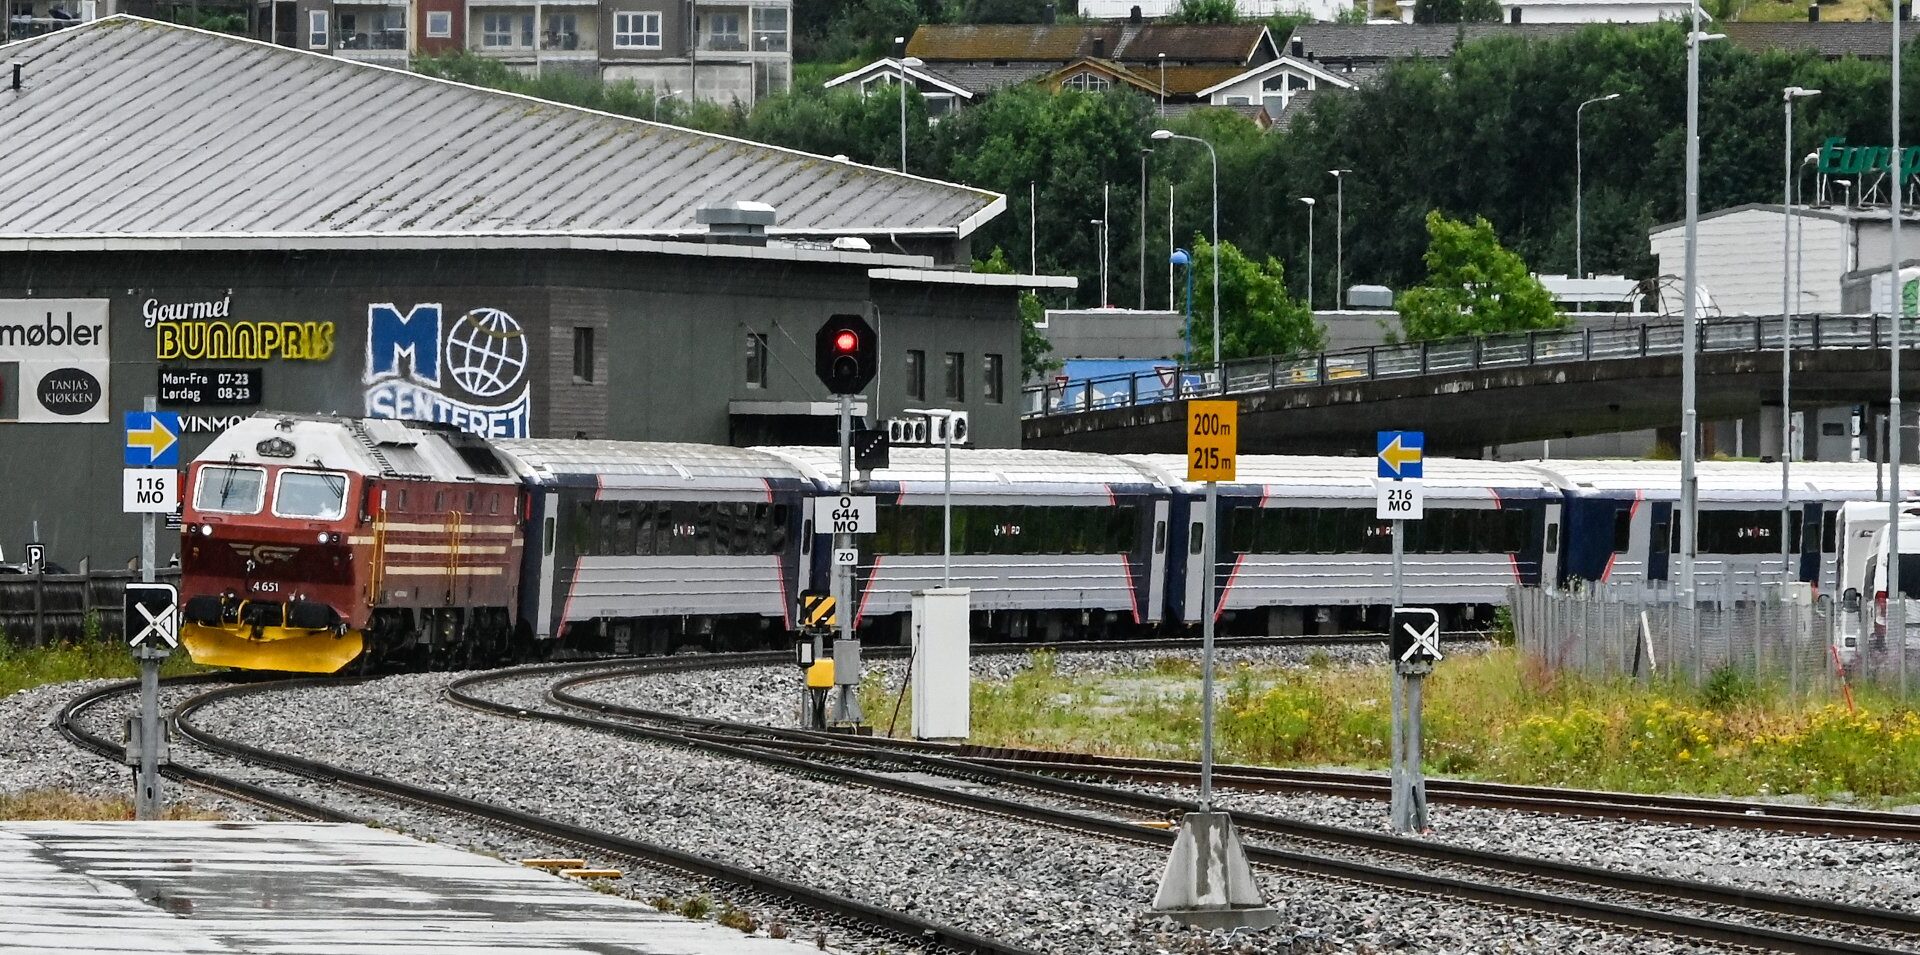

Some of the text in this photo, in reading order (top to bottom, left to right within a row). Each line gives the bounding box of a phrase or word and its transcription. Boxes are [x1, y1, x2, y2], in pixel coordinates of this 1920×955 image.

[143, 297, 230, 328] Gourmet
[0, 312, 102, 346] møbler
[157, 321, 335, 360] BUNNPRIS
[162, 373, 249, 385] Man-Fre 07-23
[45, 392, 94, 404] KJØKKEN
[162, 388, 250, 402] Lørdag 08-23
[372, 388, 525, 439] SENTERET
[136, 478, 165, 490] 116
[137, 491, 164, 504] MO
[1388, 489, 1413, 500] 216
[1388, 500, 1412, 512] MO
[832, 509, 859, 521] 644
[833, 521, 858, 533] MO
[839, 552, 854, 562] ZO
[261, 581, 279, 592] 651
